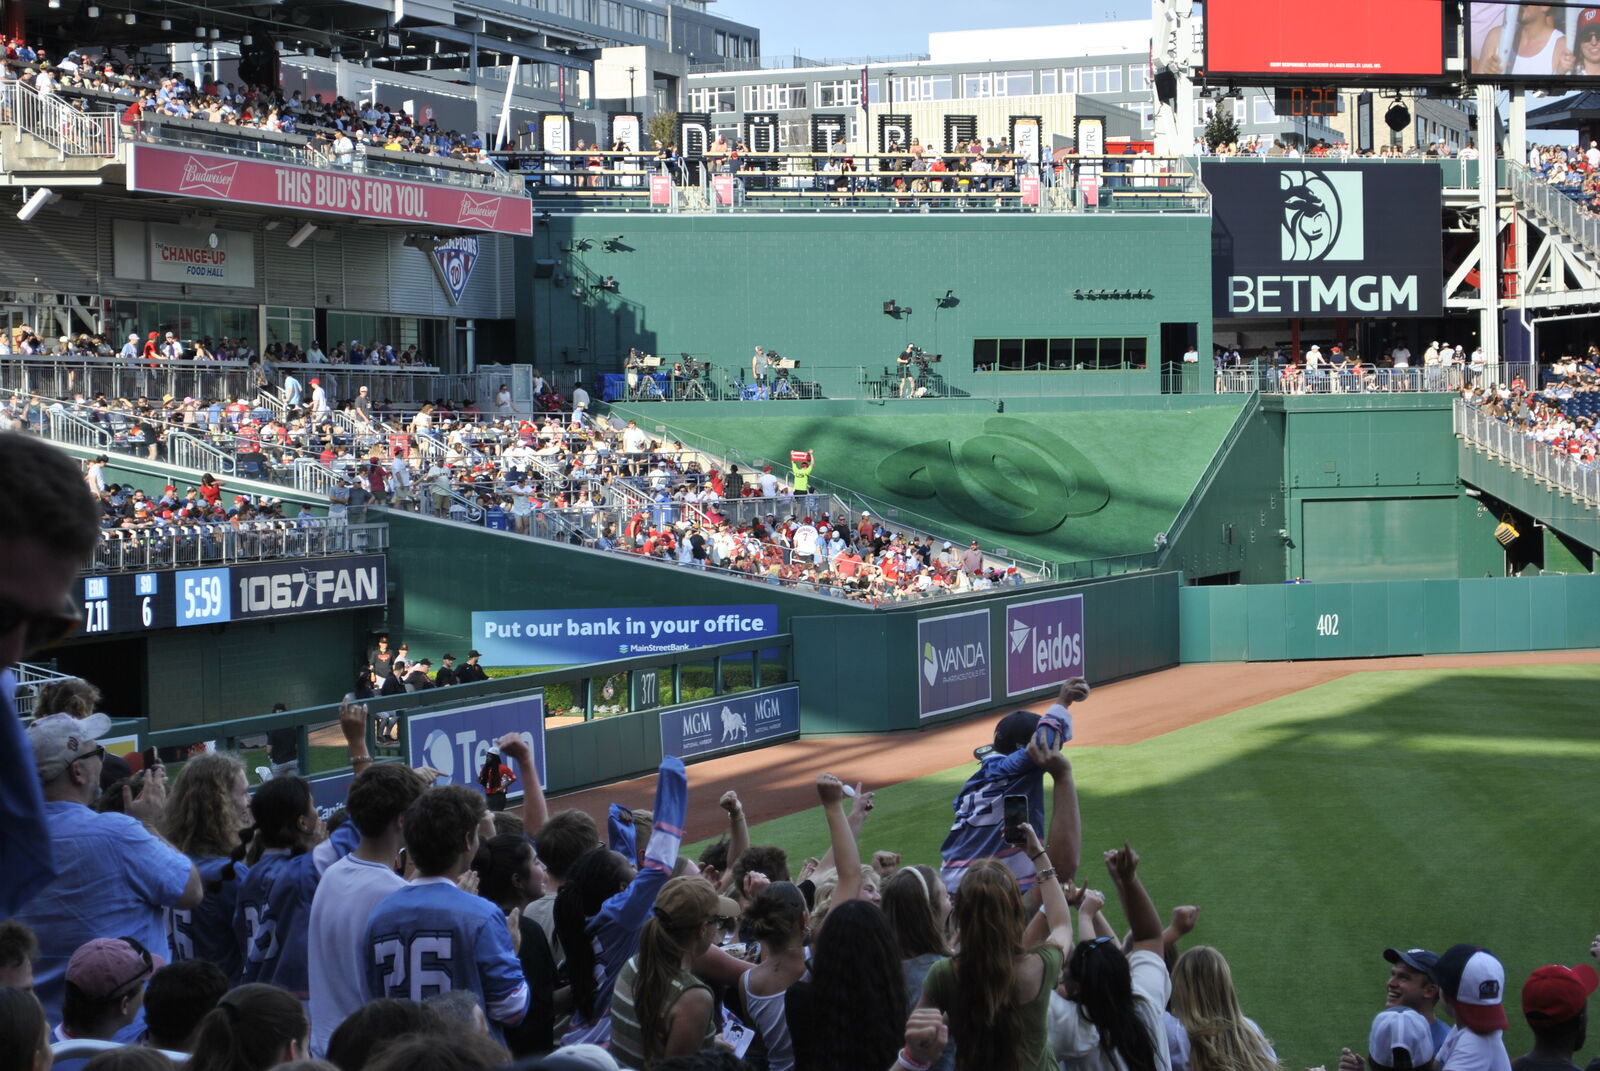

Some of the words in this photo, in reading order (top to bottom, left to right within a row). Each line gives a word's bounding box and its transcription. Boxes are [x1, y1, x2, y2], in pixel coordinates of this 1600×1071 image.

[184, 163, 233, 185] Budweiser
[275, 169, 311, 204] THIS
[315, 174, 361, 210] BUD'S
[364, 181, 393, 214] FOR
[396, 185, 428, 218] YOU.
[461, 200, 497, 217] Budweiser
[161, 246, 226, 265] CHANGE-UP
[186, 265, 205, 276] FOOD
[206, 267, 224, 277] HALL
[1228, 275, 1418, 313] BETMGM
[88, 579, 105, 598] ERA
[140, 575, 152, 593] SO
[240, 573, 309, 612] 106.7
[316, 567, 377, 605] FAN
[184, 576, 222, 619] 5:59
[85, 600, 109, 632] 7.11
[142, 597, 152, 627] 6
[1316, 613, 1339, 636] 402
[484, 621, 521, 638] Put
[525, 623, 562, 637] our
[567, 617, 620, 636] bank
[626, 616, 646, 634] in
[650, 619, 700, 639] your
[704, 614, 764, 633] office
[630, 643, 690, 652] MainStreetBank
[938, 642, 985, 673] VANDA
[1032, 622, 1081, 674] leidos
[641, 672, 656, 705] 377
[755, 698, 780, 721] MGM
[683, 711, 712, 737] MGM
[373, 936, 452, 1003] 26
